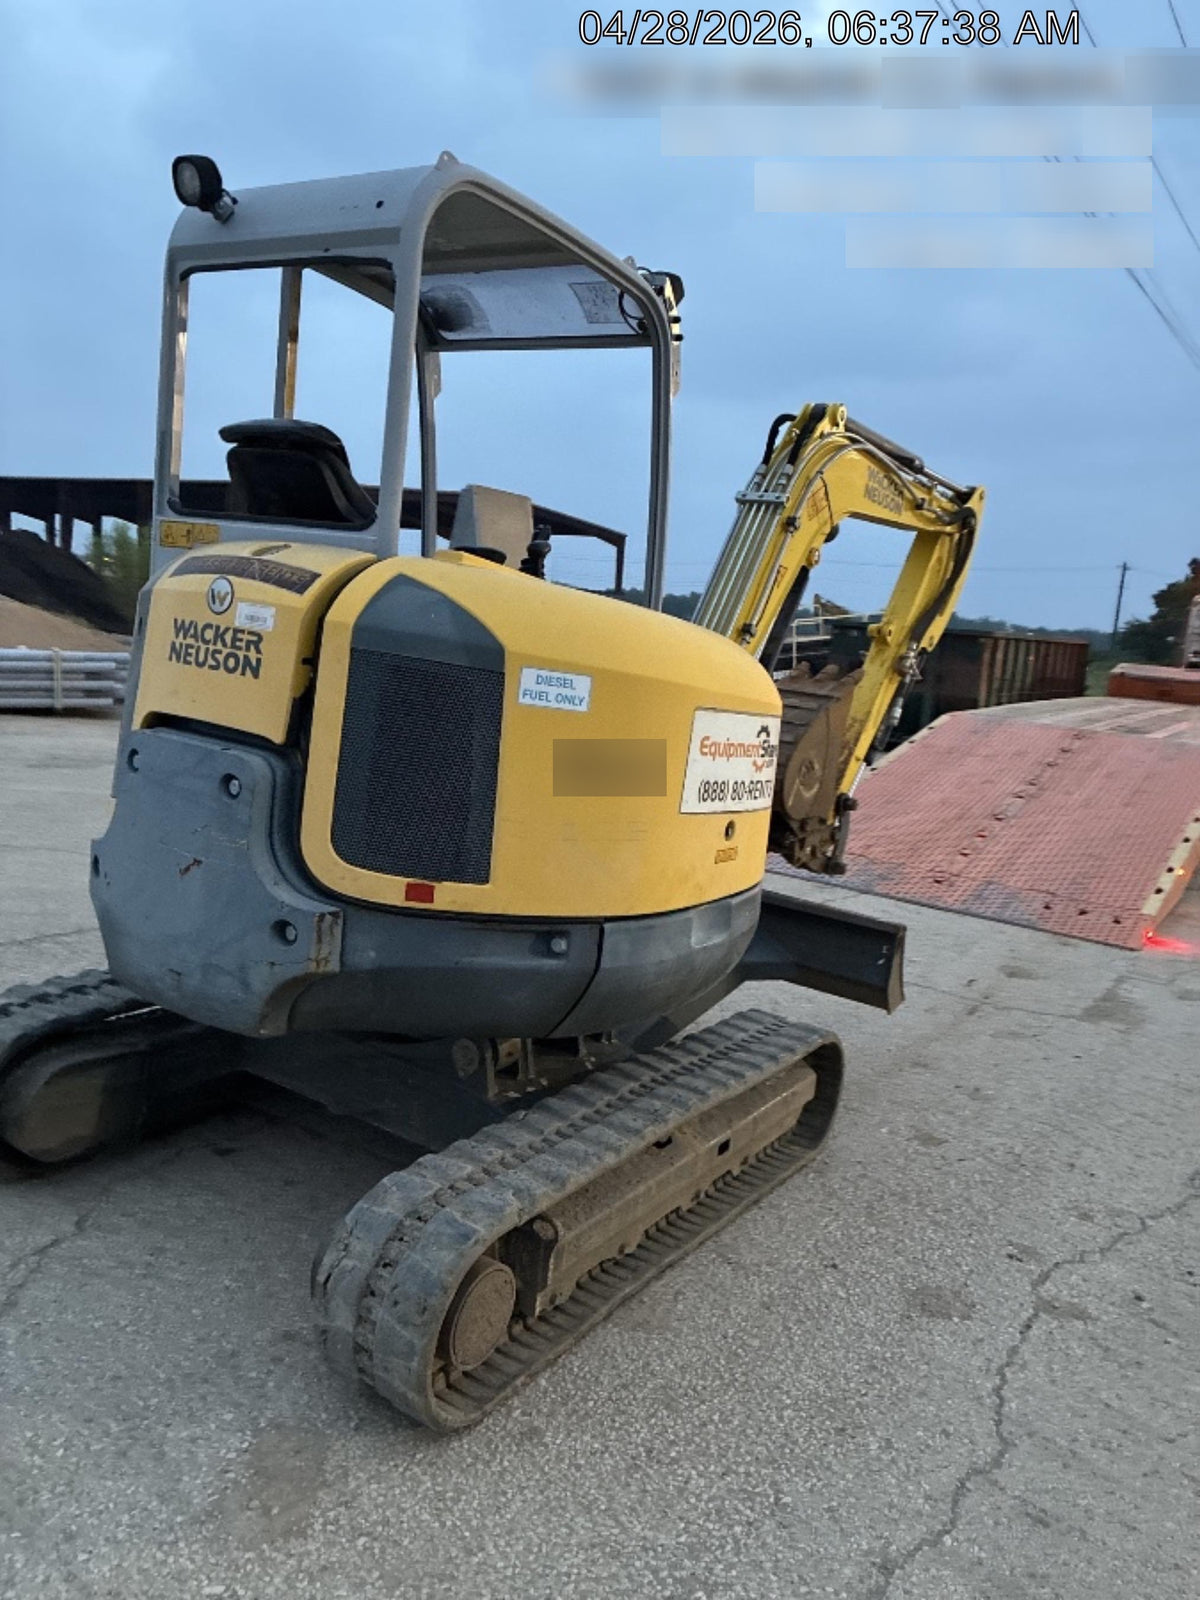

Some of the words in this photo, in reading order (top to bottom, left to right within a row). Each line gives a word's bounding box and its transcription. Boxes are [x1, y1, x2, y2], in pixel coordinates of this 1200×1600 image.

[173, 618, 263, 655] WACKER
[168, 641, 262, 679] NEUSON
[535, 674, 576, 690] DIESEL
[522, 688, 552, 703] FUEL
[554, 693, 586, 706] ONLY
[698, 779, 730, 804] (888)
